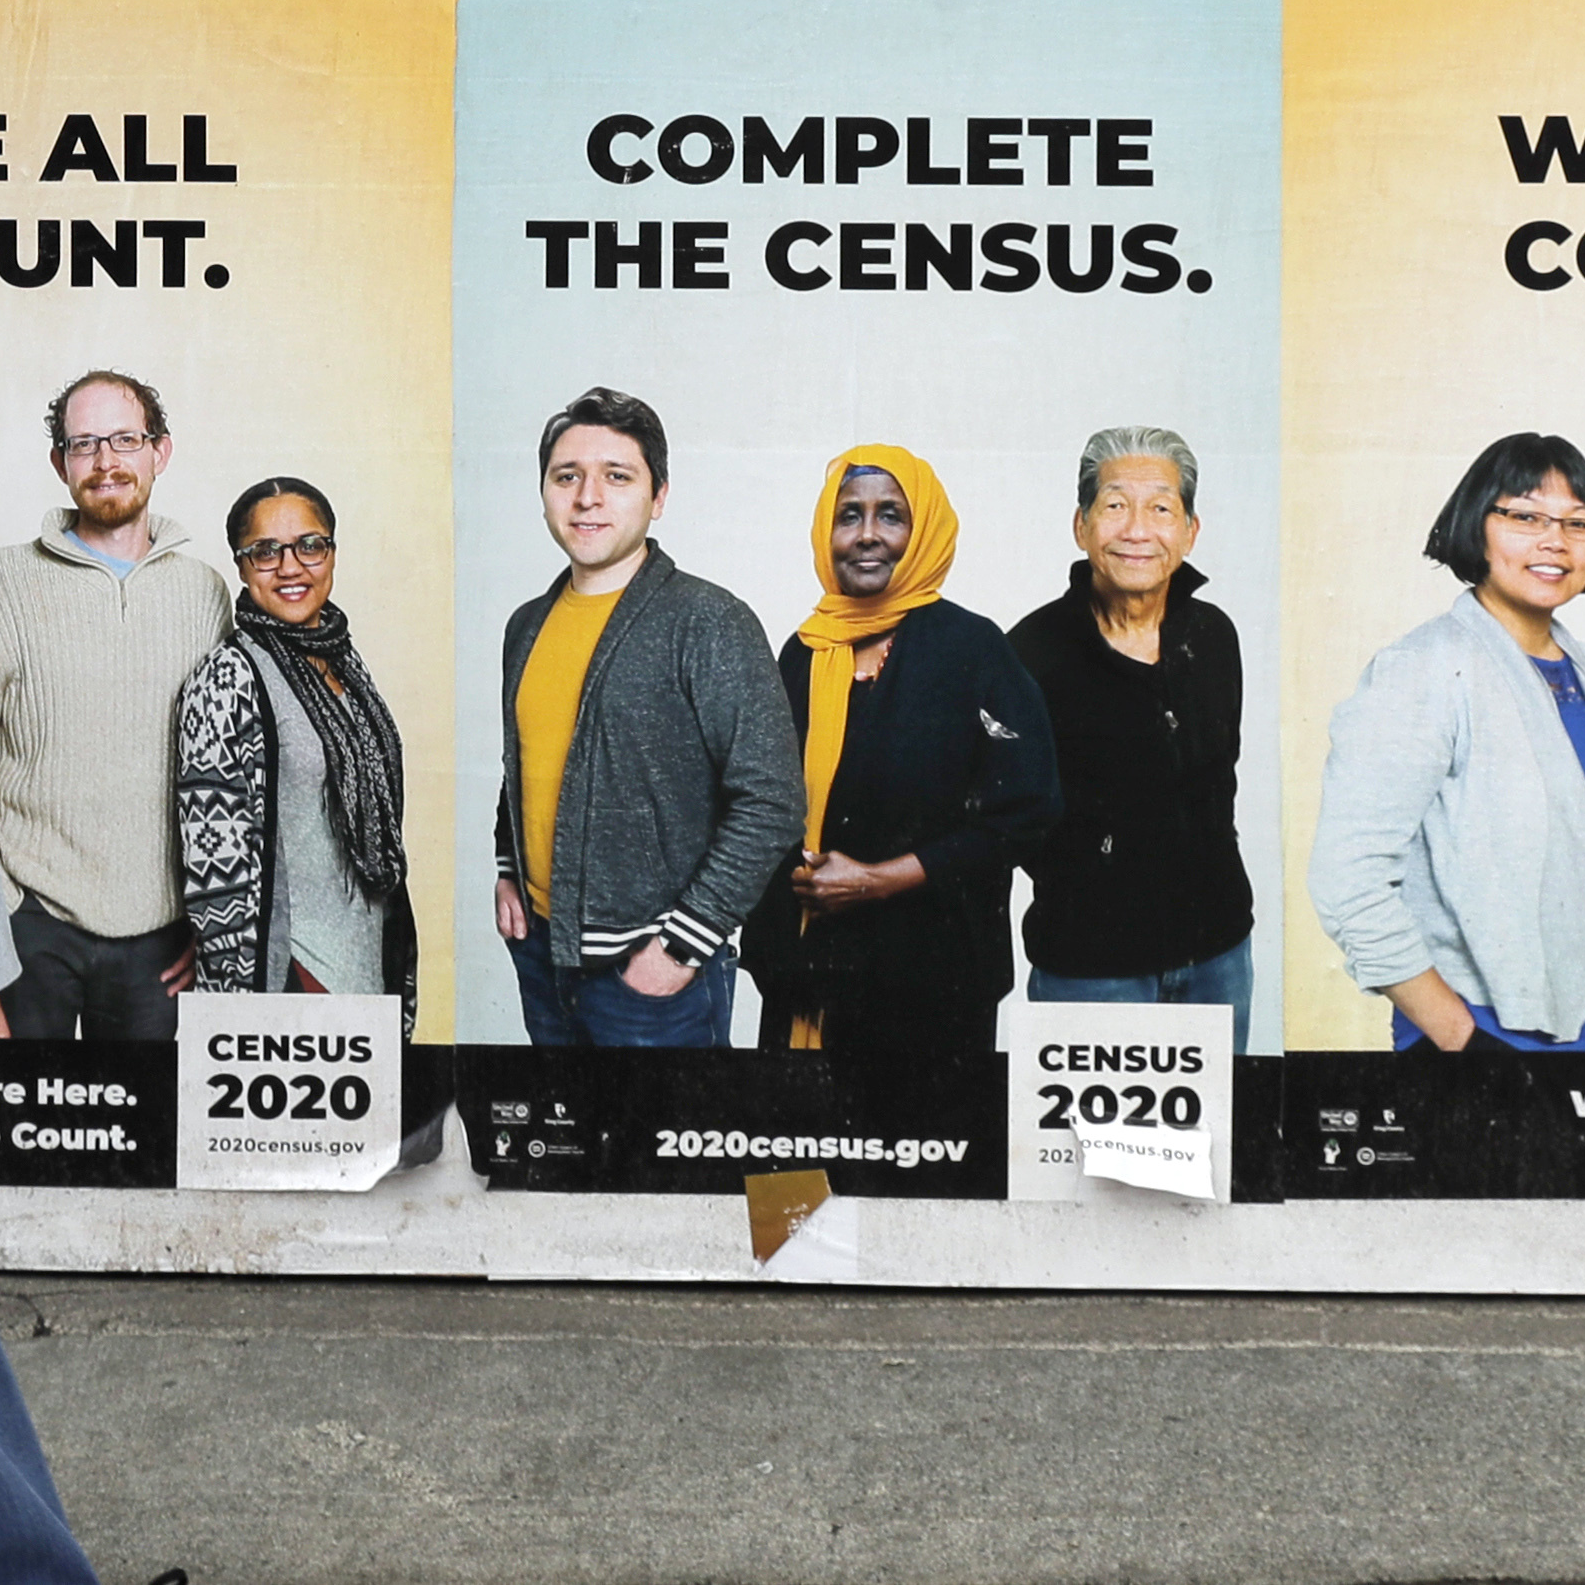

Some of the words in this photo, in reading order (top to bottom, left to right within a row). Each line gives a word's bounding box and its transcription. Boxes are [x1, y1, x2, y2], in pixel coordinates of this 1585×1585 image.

[38, 114, 238, 183] ALL
[586, 113, 1154, 187] COMPLETE
[525, 220, 730, 290] THE
[764, 220, 1213, 294] CENSUS.
[207, 1033, 373, 1064] CENSUS
[1038, 1043, 1204, 1074] CENSUS
[37, 1078, 138, 1106] Here.
[206, 1073, 371, 1121] 2020
[1038, 1084, 1202, 1130] 2020
[11, 1122, 137, 1151] Count.
[208, 1137, 365, 1157] 2020census.gov
[656, 1129, 969, 1168] 2020census.gov
